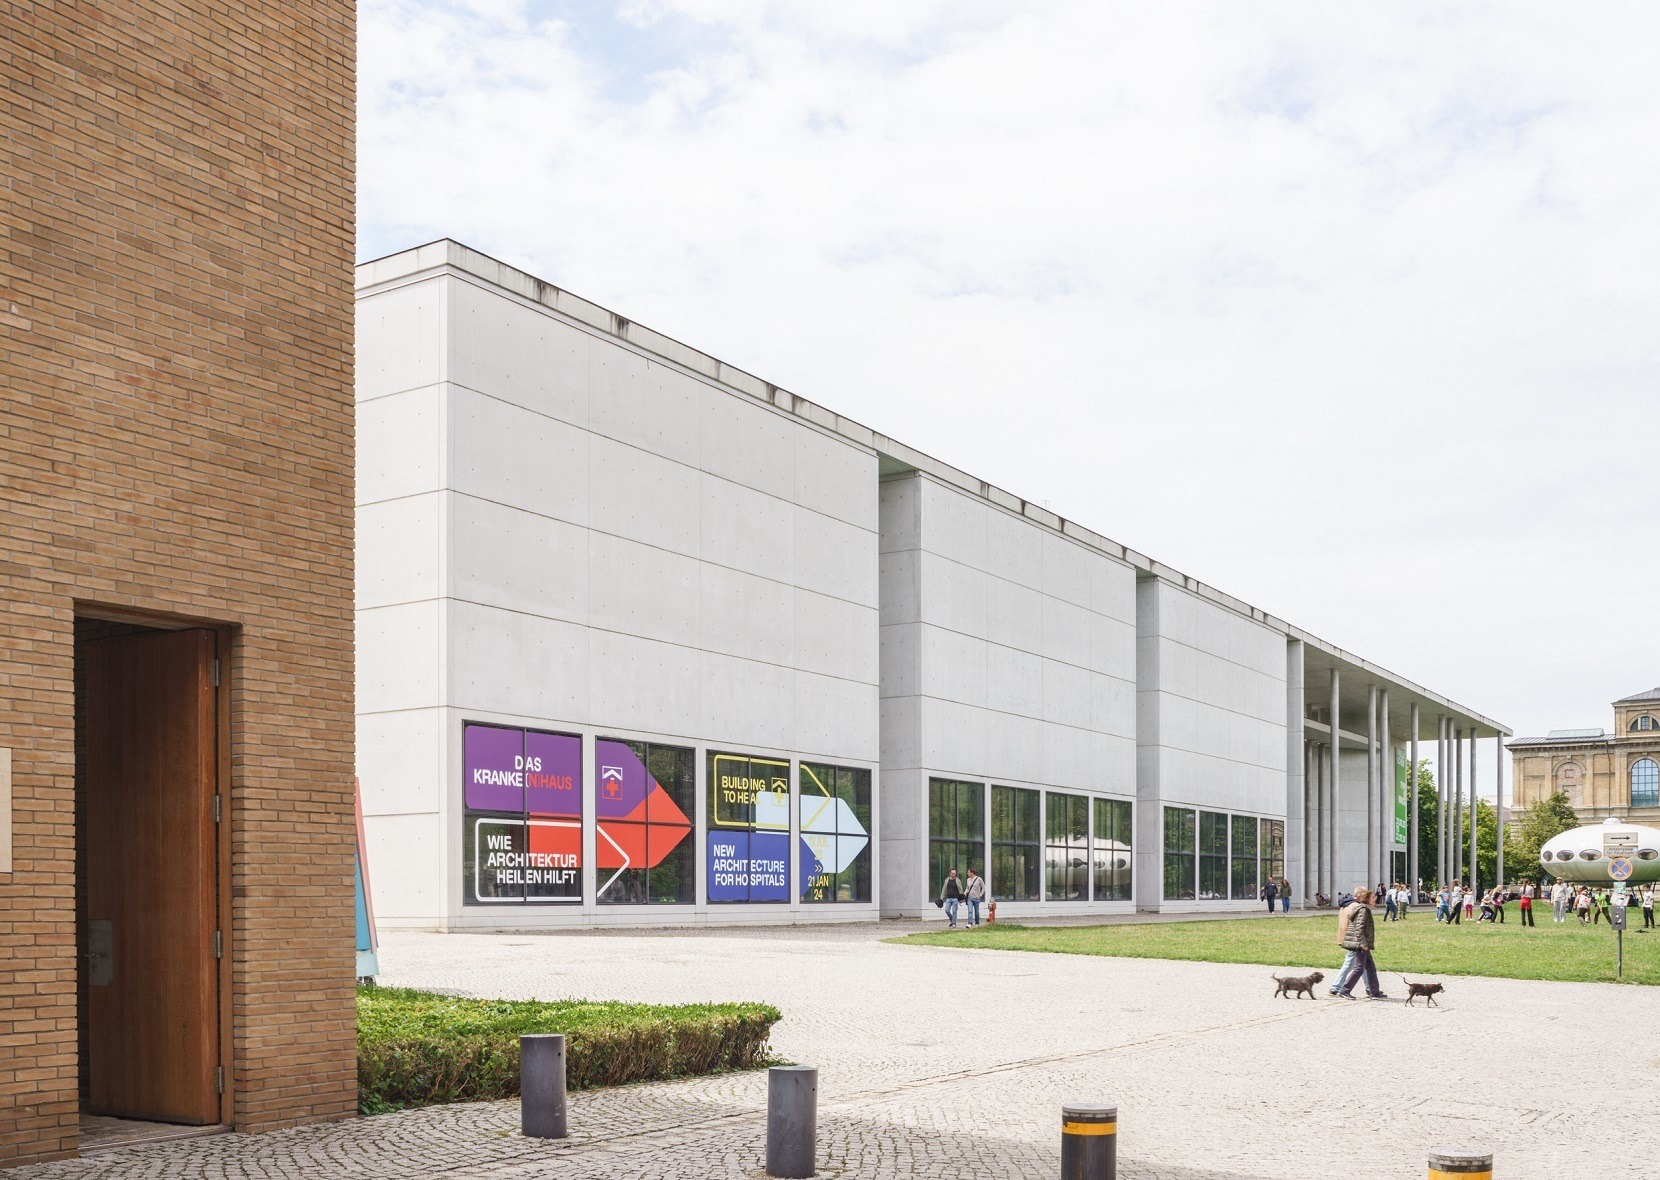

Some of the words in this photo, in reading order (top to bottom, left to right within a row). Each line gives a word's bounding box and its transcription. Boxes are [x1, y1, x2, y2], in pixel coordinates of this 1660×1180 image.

[514, 755, 541, 772] DAS
[721, 776, 766, 791] BUILDING
[723, 790, 735, 804] TO
[487, 835, 512, 850] WIE
[713, 844, 735, 857] NEW
[487, 852, 577, 868] ARCHITEKTUR
[713, 859, 785, 872] ARCHITECTURE
[496, 869, 541, 884] HEILEN
[544, 870, 576, 884] HILFT
[715, 873, 734, 886] FOR
[735, 874, 785, 887] HOSPITALS
[808, 876, 815, 887] 21
[816, 876, 829, 887] JAN
[814, 889, 823, 900] 24
